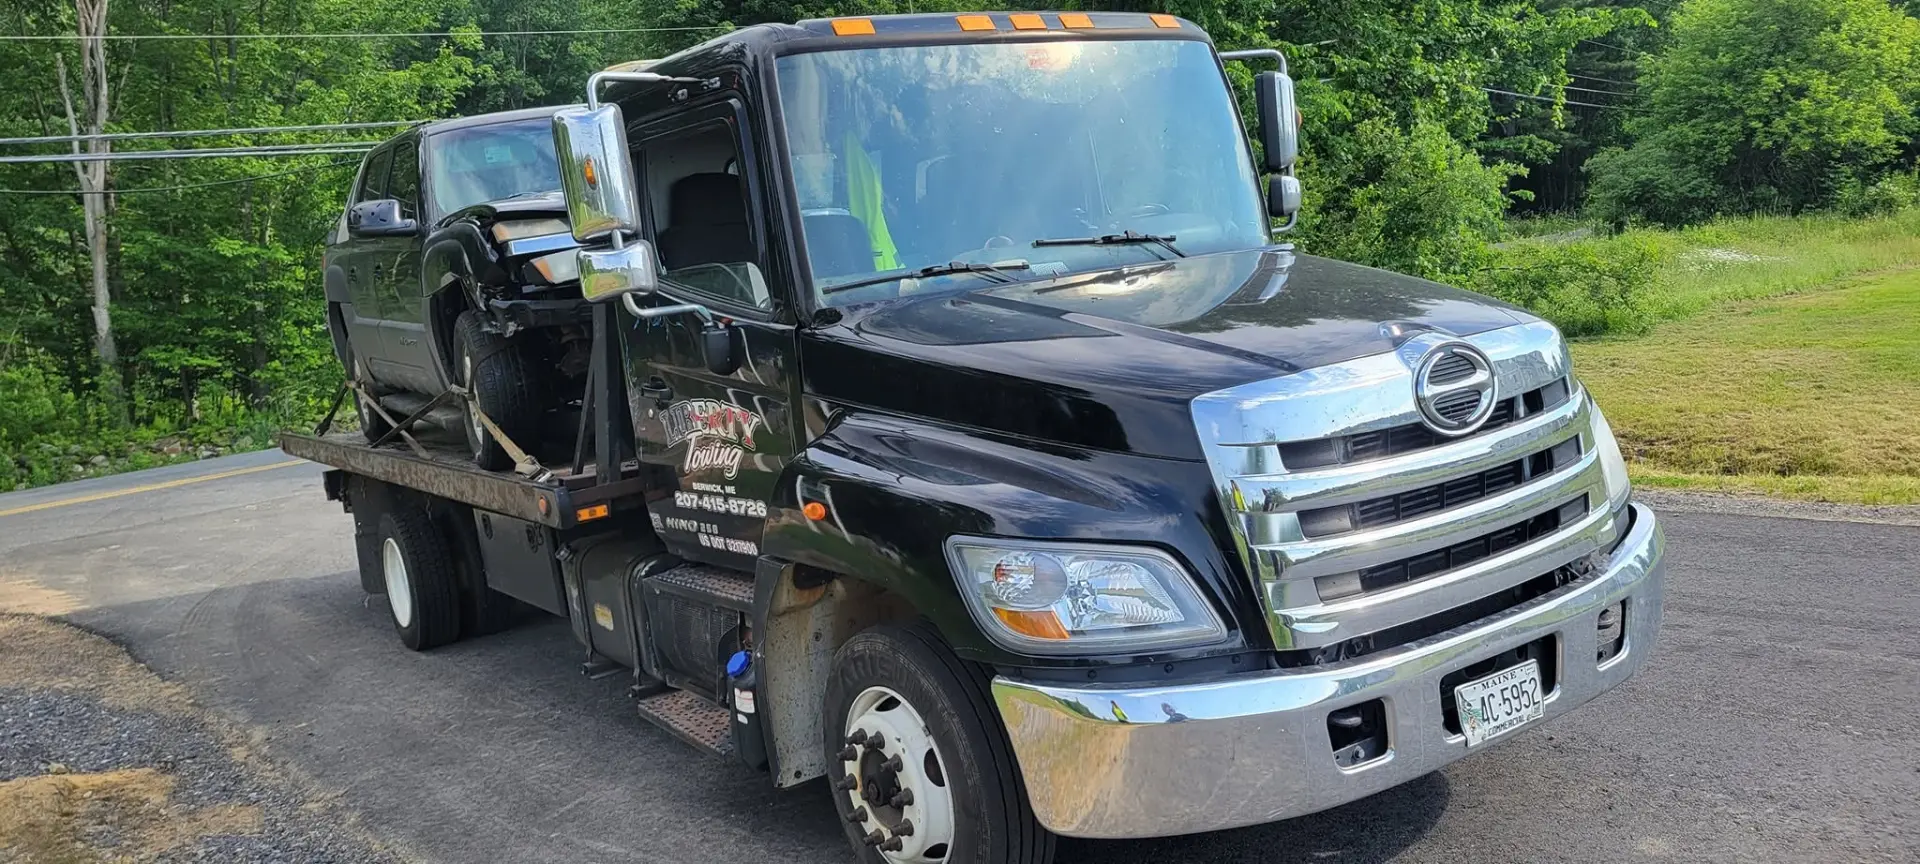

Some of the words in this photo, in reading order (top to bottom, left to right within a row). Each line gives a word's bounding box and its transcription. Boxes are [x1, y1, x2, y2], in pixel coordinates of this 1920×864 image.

[660, 398, 761, 451] LIBERTY
[684, 429, 744, 480] Towing
[725, 485, 737, 495] ME
[674, 490, 768, 518] 207-415-8726
[665, 517, 698, 532] HINO
[699, 522, 719, 535] 258
[698, 533, 711, 547] US
[709, 535, 727, 551] DOT
[1481, 670, 1517, 691] MAINE
